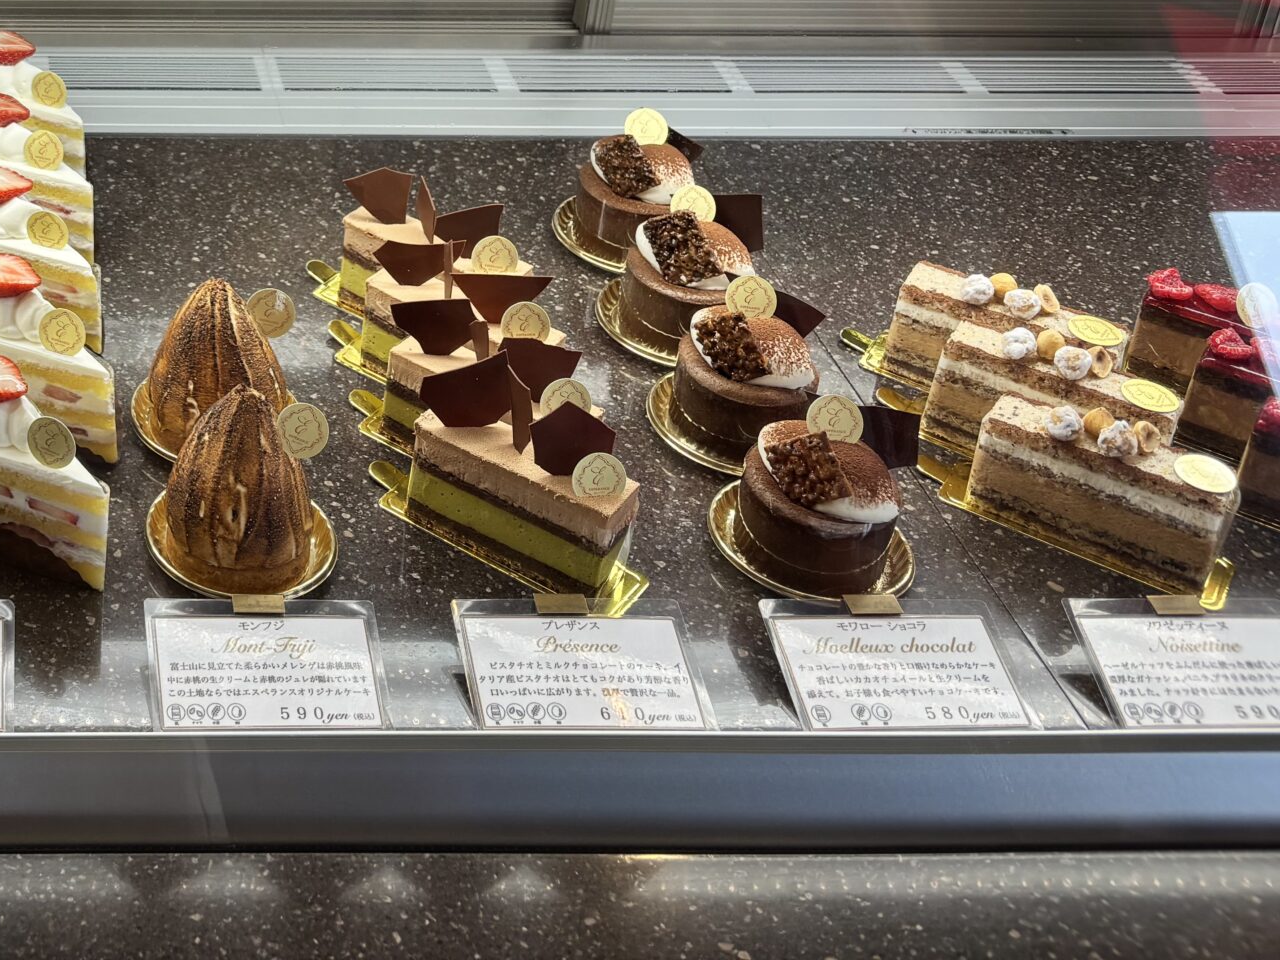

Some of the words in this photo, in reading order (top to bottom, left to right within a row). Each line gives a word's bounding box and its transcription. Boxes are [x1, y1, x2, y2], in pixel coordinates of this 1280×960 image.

[238, 620, 285, 631] モンフジ
[542, 619, 600, 631] プレザンス
[888, 621, 927, 632] ショコラ
[210, 636, 317, 659] Mont-Fuji
[533, 635, 621, 653] Présence
[802, 637, 895, 654] Moelleux
[900, 637, 977, 653] chocolat
[1149, 636, 1243, 653] Noisettine
